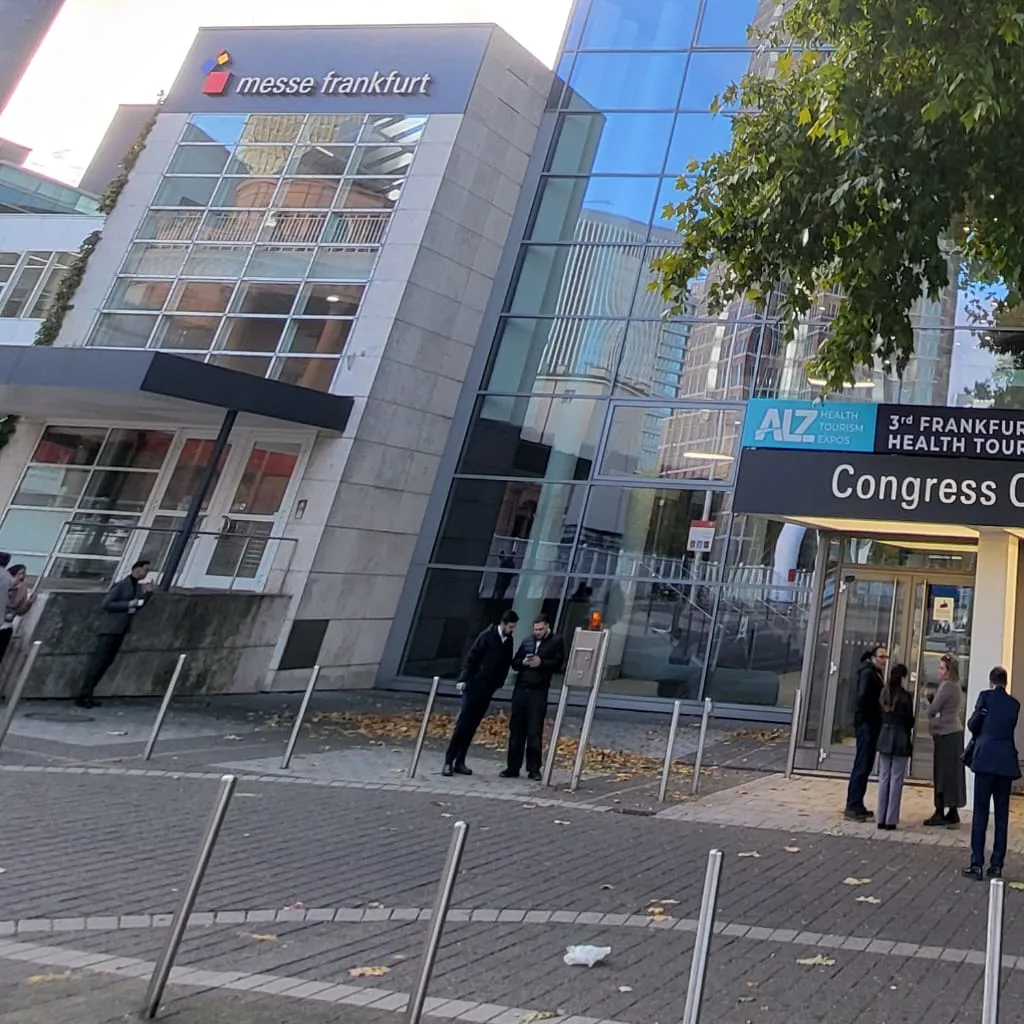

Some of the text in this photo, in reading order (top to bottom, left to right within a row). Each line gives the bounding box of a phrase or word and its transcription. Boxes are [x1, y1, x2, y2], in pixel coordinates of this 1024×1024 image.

[236, 71, 431, 94] messe frankfurt
[820, 410, 859, 420] HEALTH
[889, 415, 913, 431] 3rd
[755, 408, 818, 443] ALZ
[819, 422, 864, 433] TOURISM
[817, 434, 850, 445] EXPOS
[888, 433, 965, 453] HEALTH
[831, 464, 998, 510] Congress
